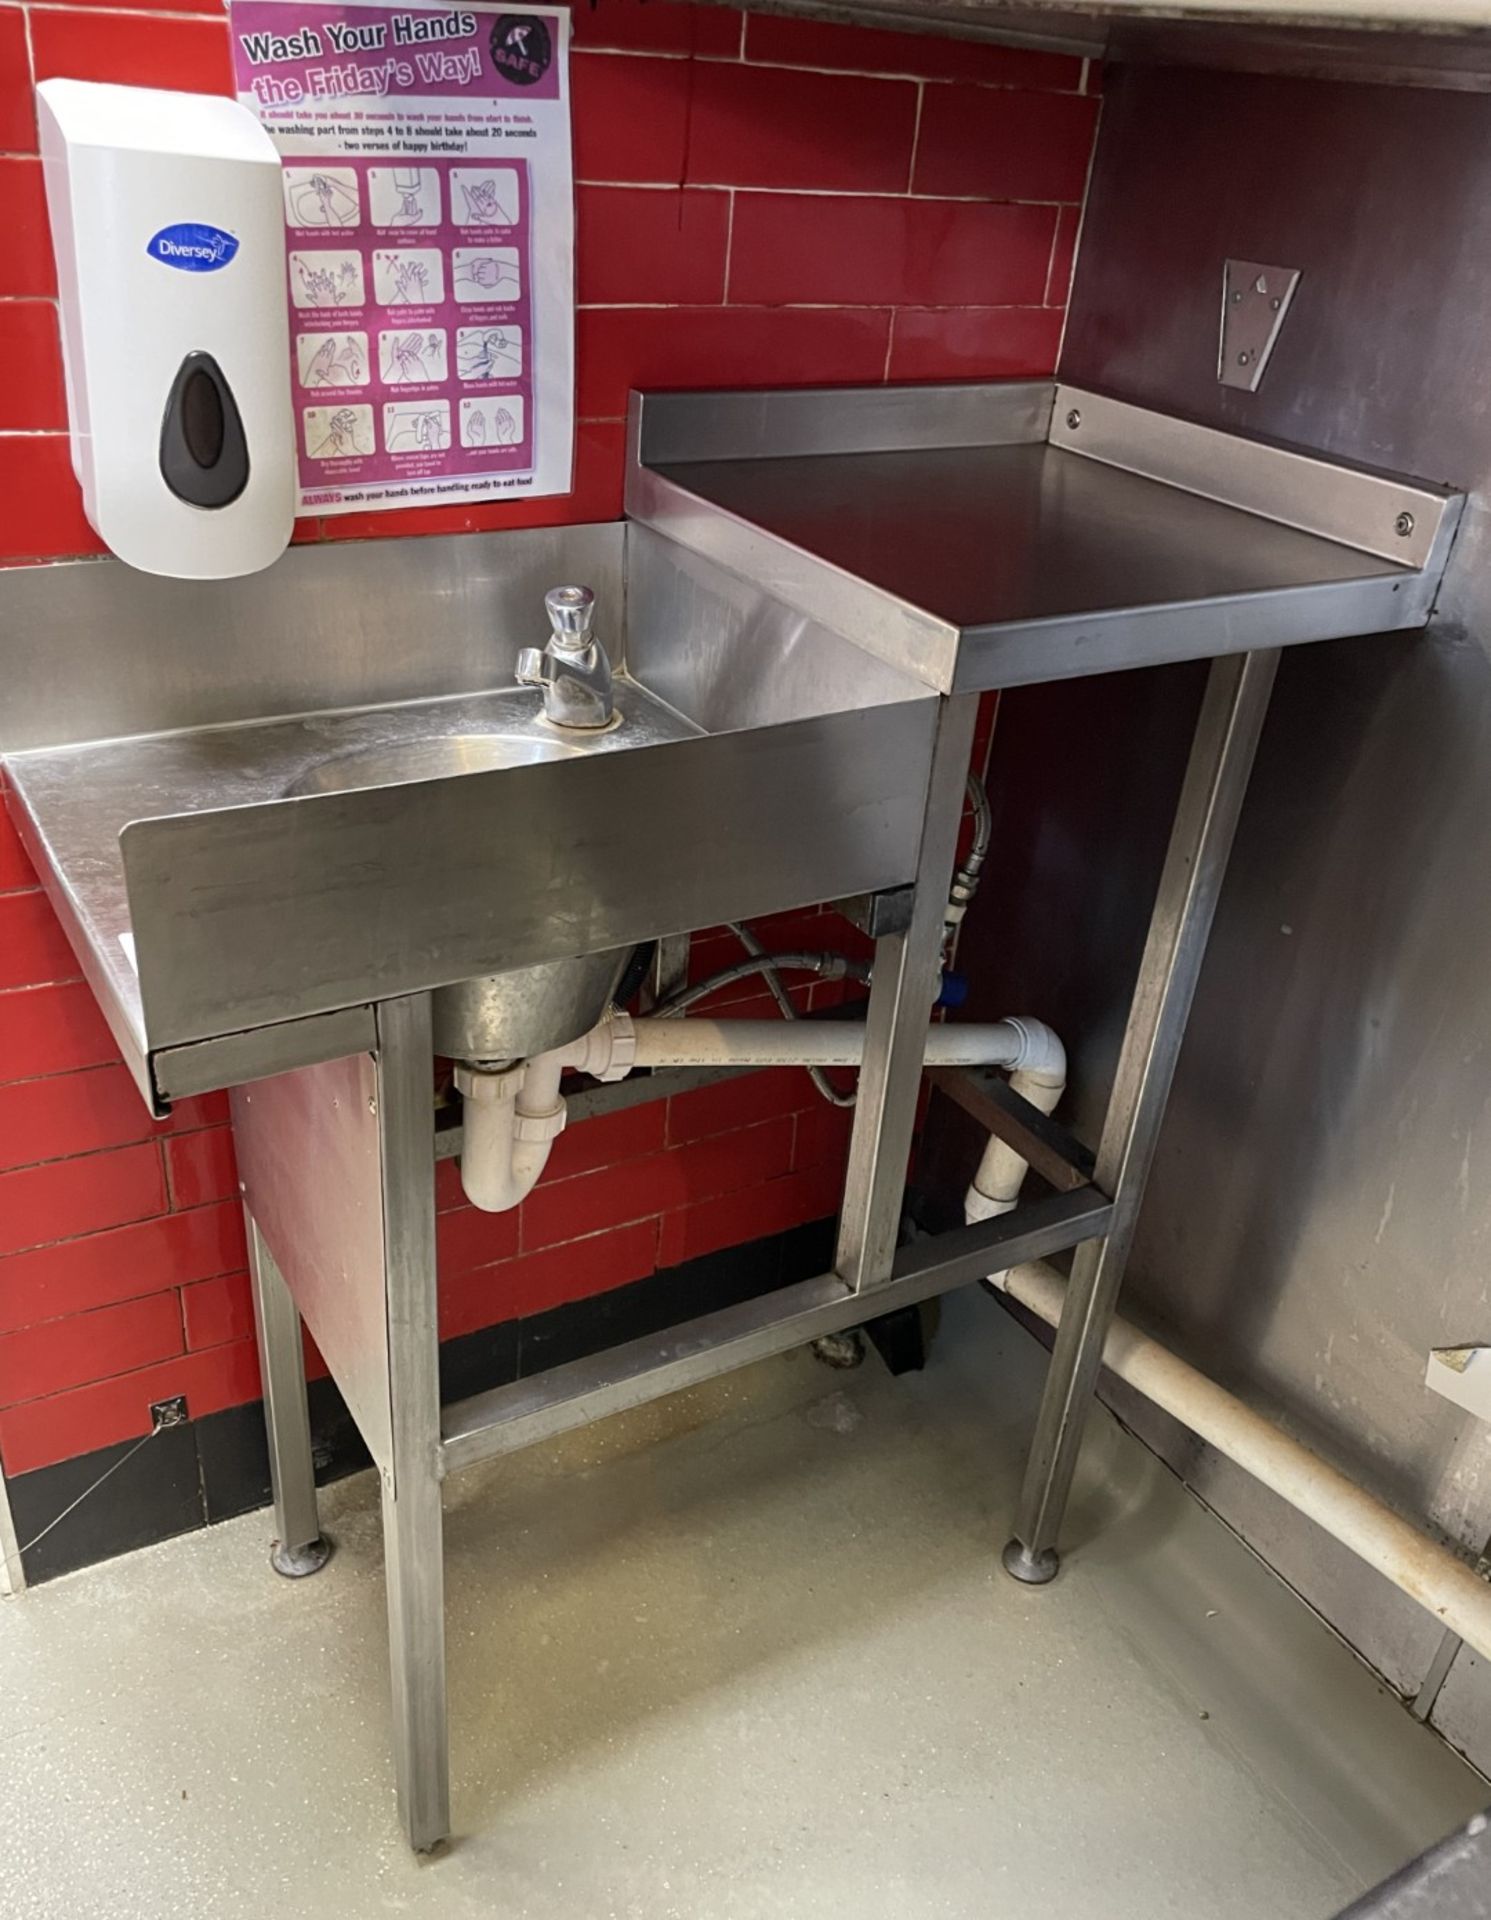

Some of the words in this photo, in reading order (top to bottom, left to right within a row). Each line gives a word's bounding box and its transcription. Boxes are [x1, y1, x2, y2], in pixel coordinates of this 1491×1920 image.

[240, 28, 322, 63] Wash
[323, 23, 387, 53] Your
[392, 10, 476, 45] Hands
[252, 76, 302, 104] the
[306, 58, 414, 97] Friday's
[415, 47, 482, 84] Way!
[495, 48, 540, 77] SAFE
[278, 124, 314, 136] washing
[317, 126, 335, 136] part
[338, 125, 358, 134] from
[361, 126, 384, 136] steps
[388, 126, 393, 135] 4
[396, 126, 404, 136] to
[415, 126, 442, 136] should
[445, 127, 463, 136] take
[466, 127, 489, 137] about
[492, 128, 502, 137] 20
[505, 128, 537, 137] seconds
[344, 140, 360, 150] two
[362, 142, 390, 150] verses
[392, 140, 400, 150] of
[402, 140, 428, 153] happy
[159, 239, 216, 263] Diversey
[302, 492, 342, 506] ALWAYS
[344, 492, 364, 501] wash
[366, 492, 383, 502] your
[385, 489, 409, 498] hands
[411, 487, 435, 495] before
[437, 483, 469, 492] handling
[471, 480, 491, 489] ready
[493, 480, 501, 488] to
[503, 479, 515, 487] eat
[517, 477, 532, 485] food
